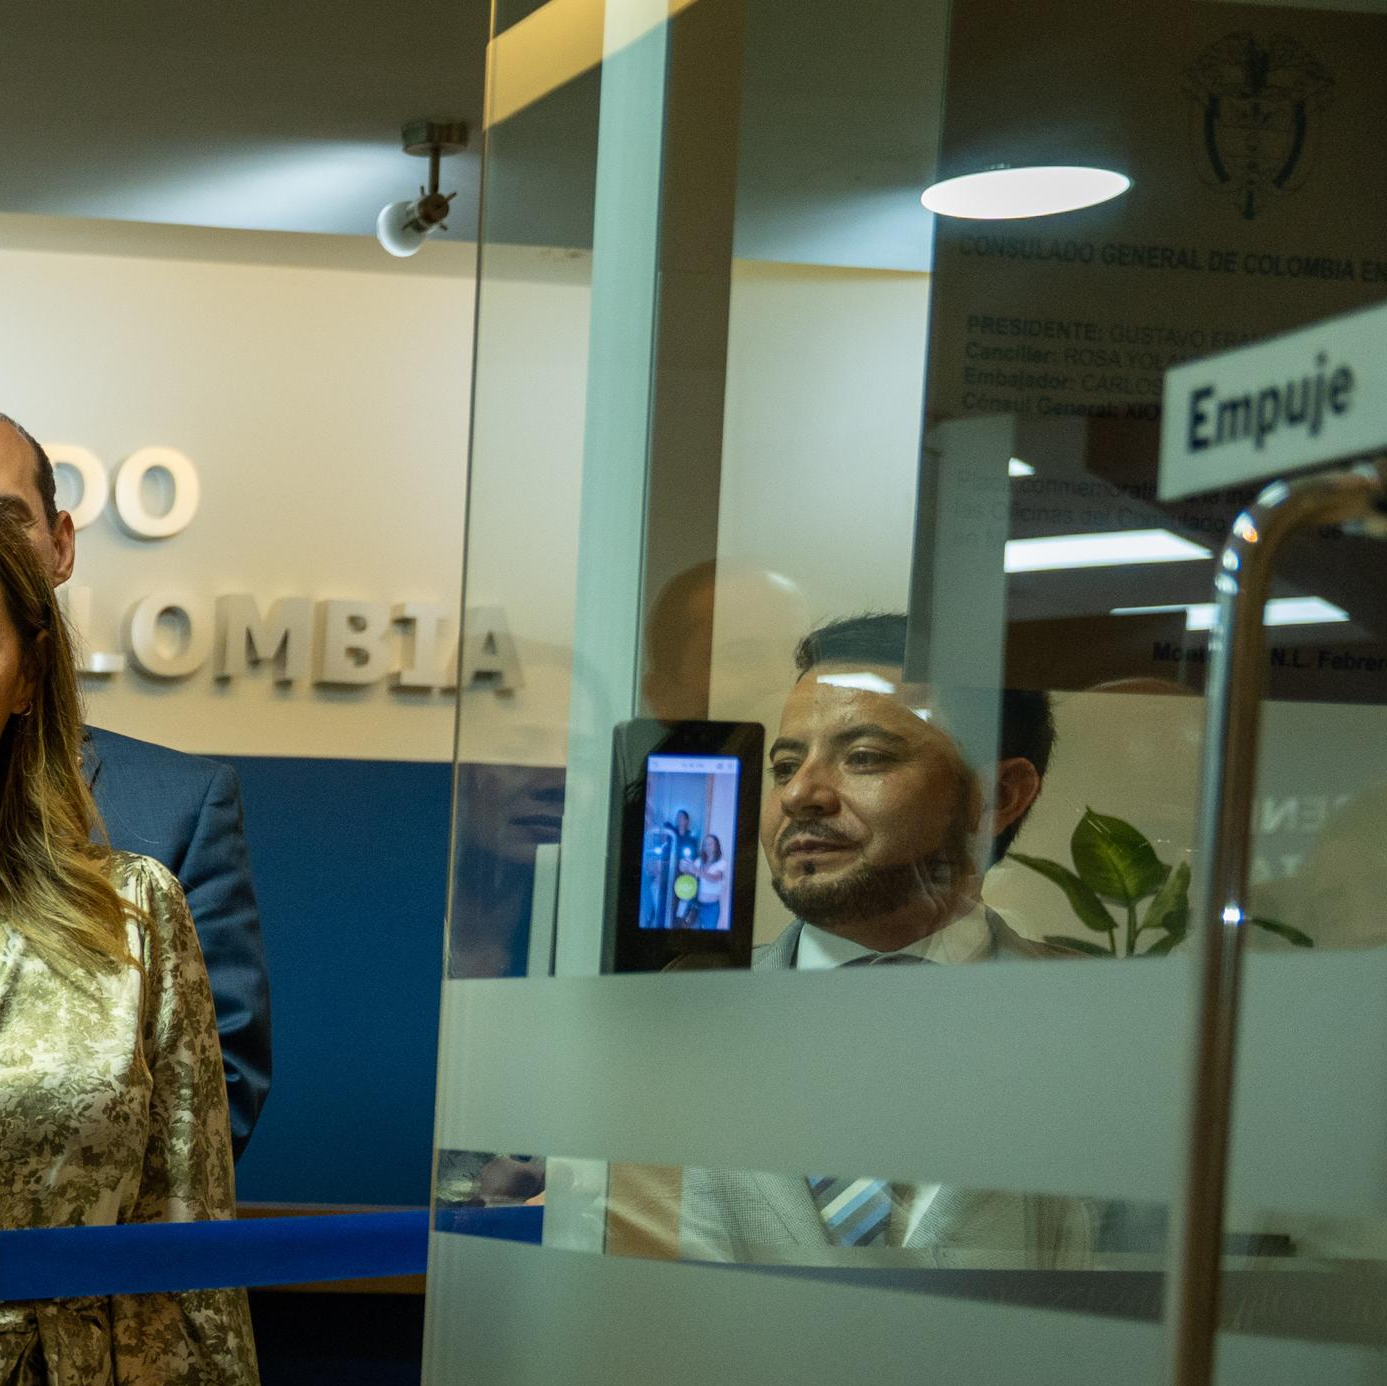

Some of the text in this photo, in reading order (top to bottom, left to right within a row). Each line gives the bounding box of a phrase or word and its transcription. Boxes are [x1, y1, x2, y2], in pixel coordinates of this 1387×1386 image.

[1102, 242, 1201, 271] GENERAL
[1208, 250, 1238, 274] DE
[1245, 254, 1355, 281] COLOMBIA
[1187, 350, 1355, 454] Empuje
